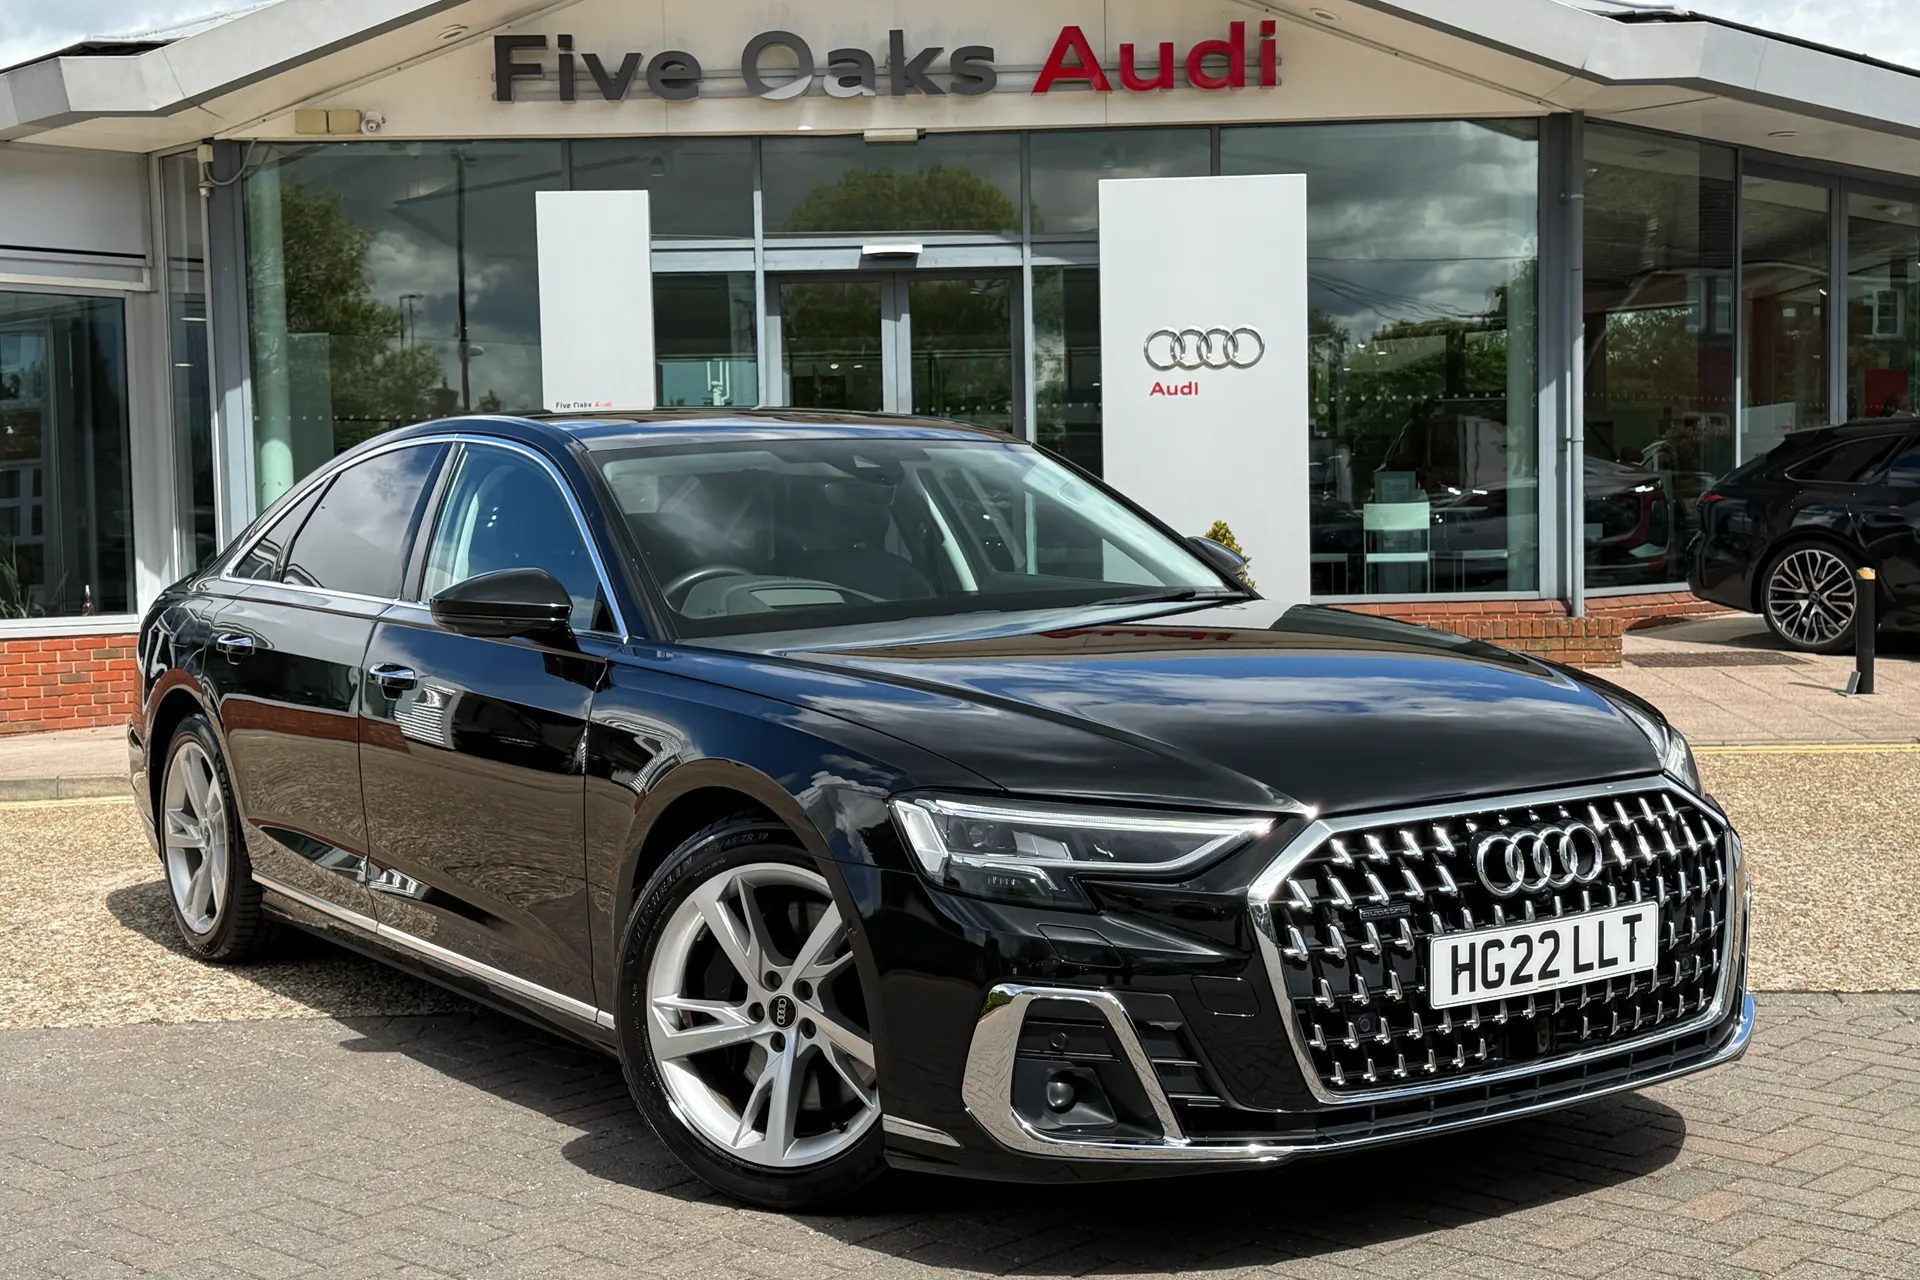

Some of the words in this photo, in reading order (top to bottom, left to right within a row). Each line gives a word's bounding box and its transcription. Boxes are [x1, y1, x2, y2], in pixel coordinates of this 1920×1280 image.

[494, 34, 702, 101] Five
[741, 29, 998, 101] Oaks
[1031, 20, 1277, 94] Audi
[555, 401, 571, 409] Five
[1149, 381, 1199, 396] Audi
[1451, 929, 1560, 996] HG22
[1573, 913, 1642, 974] LLT
